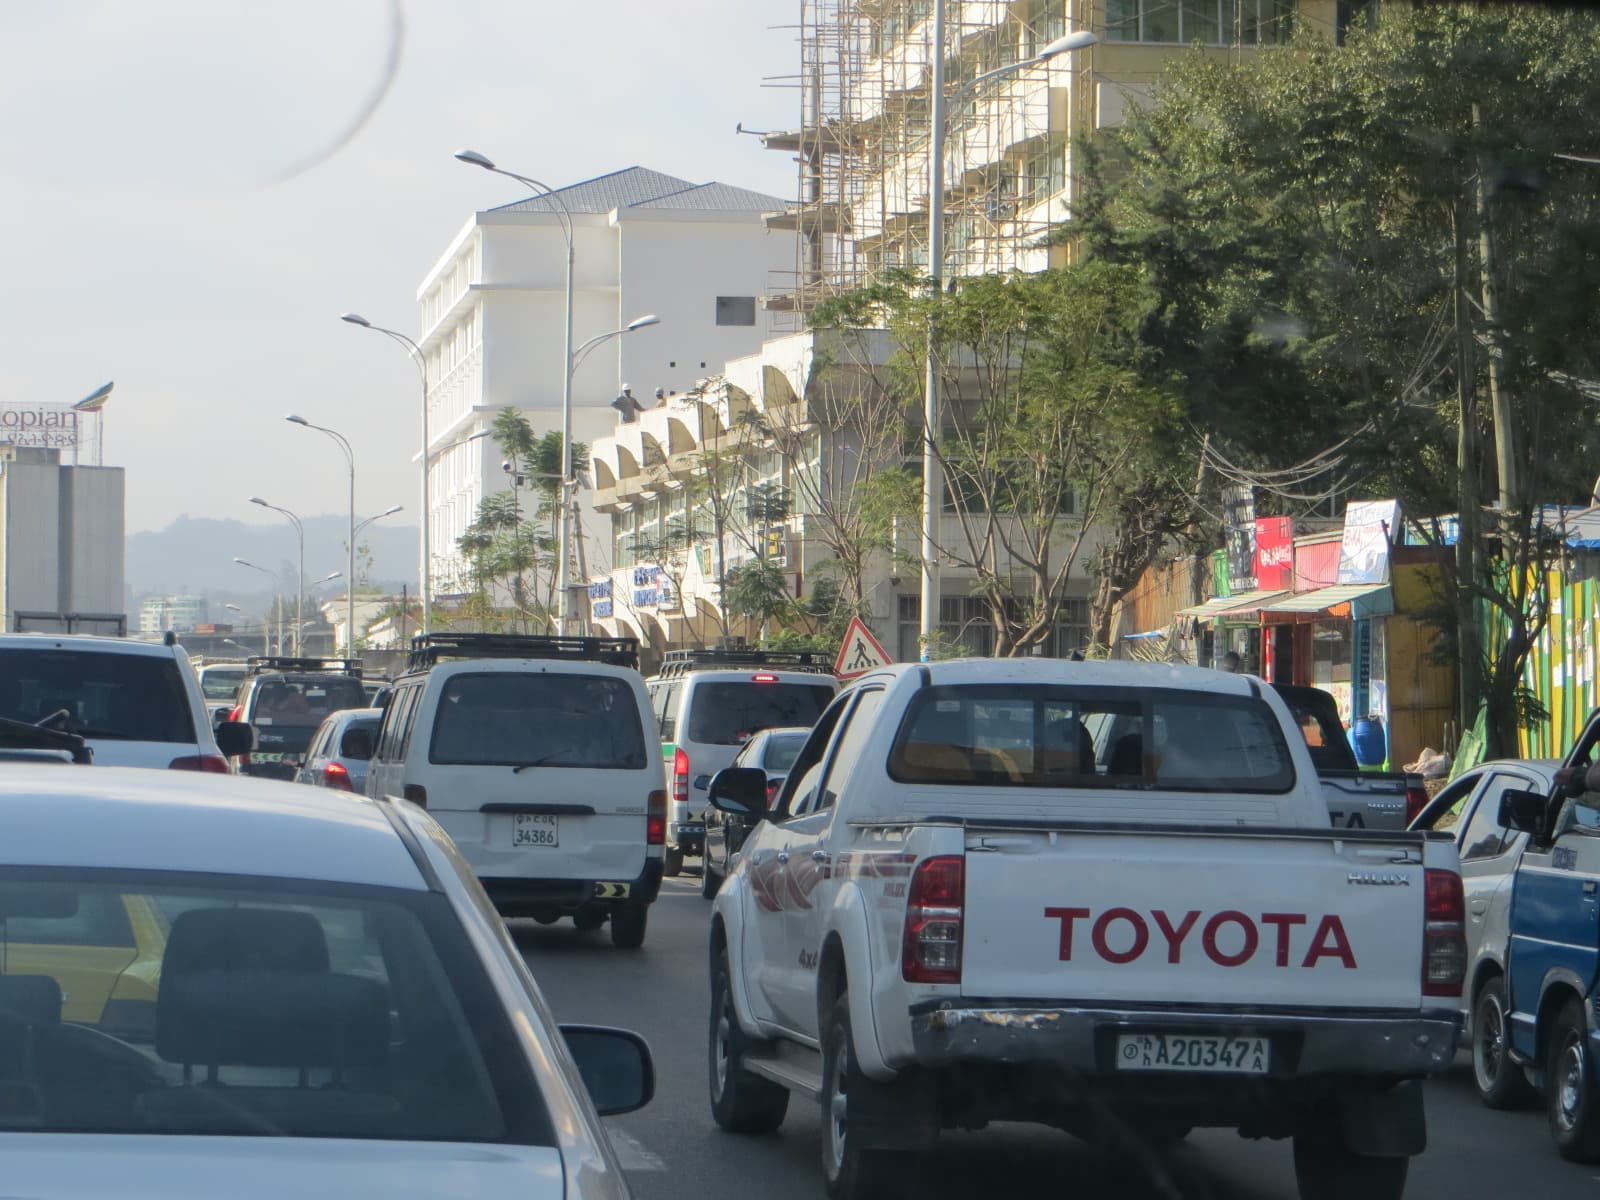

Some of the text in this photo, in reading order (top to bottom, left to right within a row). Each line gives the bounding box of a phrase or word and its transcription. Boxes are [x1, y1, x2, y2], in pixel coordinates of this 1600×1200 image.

[0, 408, 77, 431] opian
[516, 830, 554, 843] 34386
[1347, 872, 1411, 887] HILUX
[1044, 906, 1358, 969] TOYOTA
[1155, 1036, 1250, 1067] A20347
